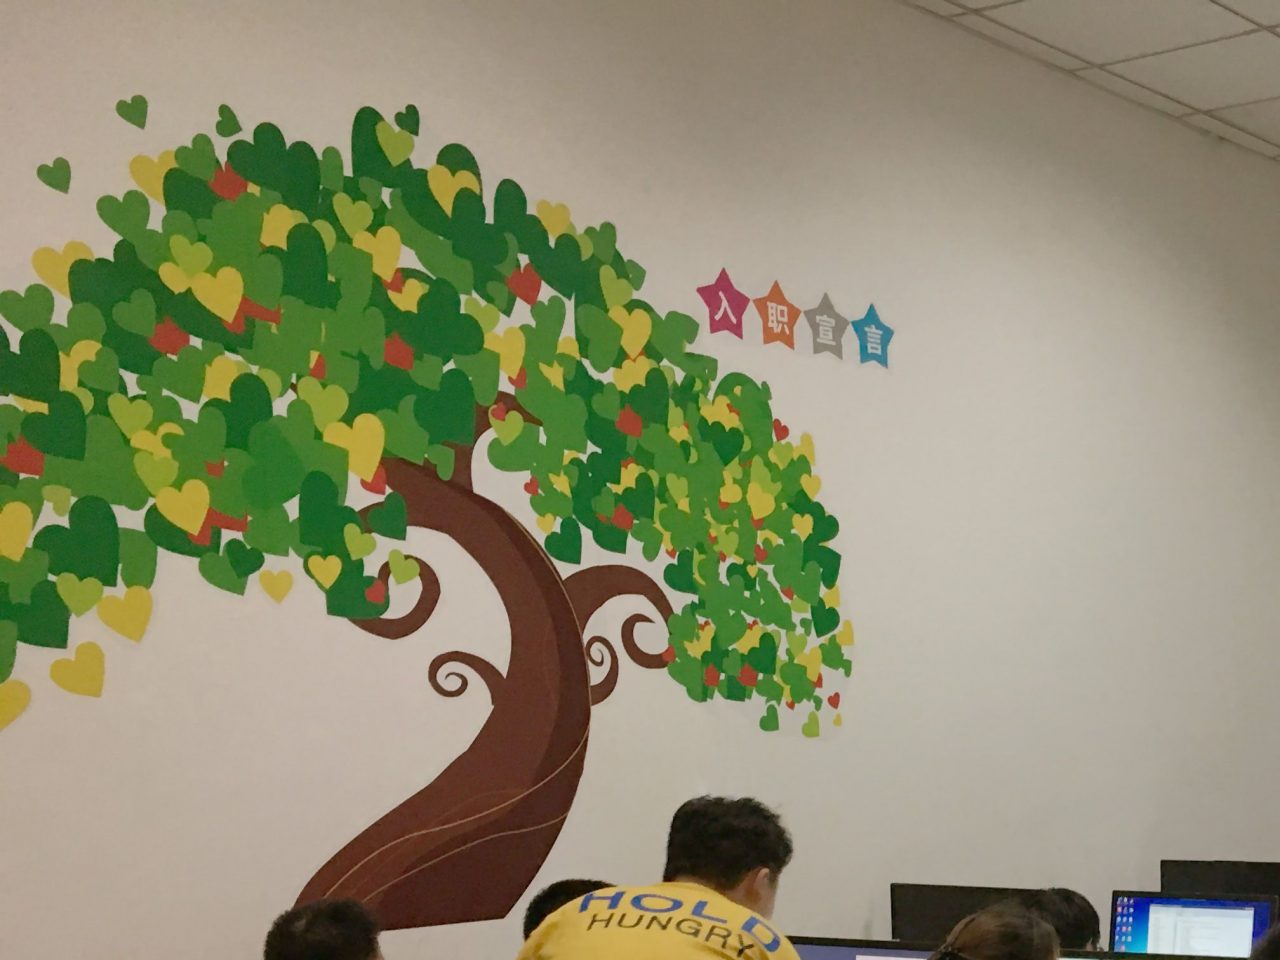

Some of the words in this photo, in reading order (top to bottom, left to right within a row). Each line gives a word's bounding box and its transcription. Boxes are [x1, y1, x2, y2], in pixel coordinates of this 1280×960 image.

[715, 291, 883, 355] 入职宣言
[578, 891, 781, 953] HOLD
[586, 913, 754, 958] HUNGRY
